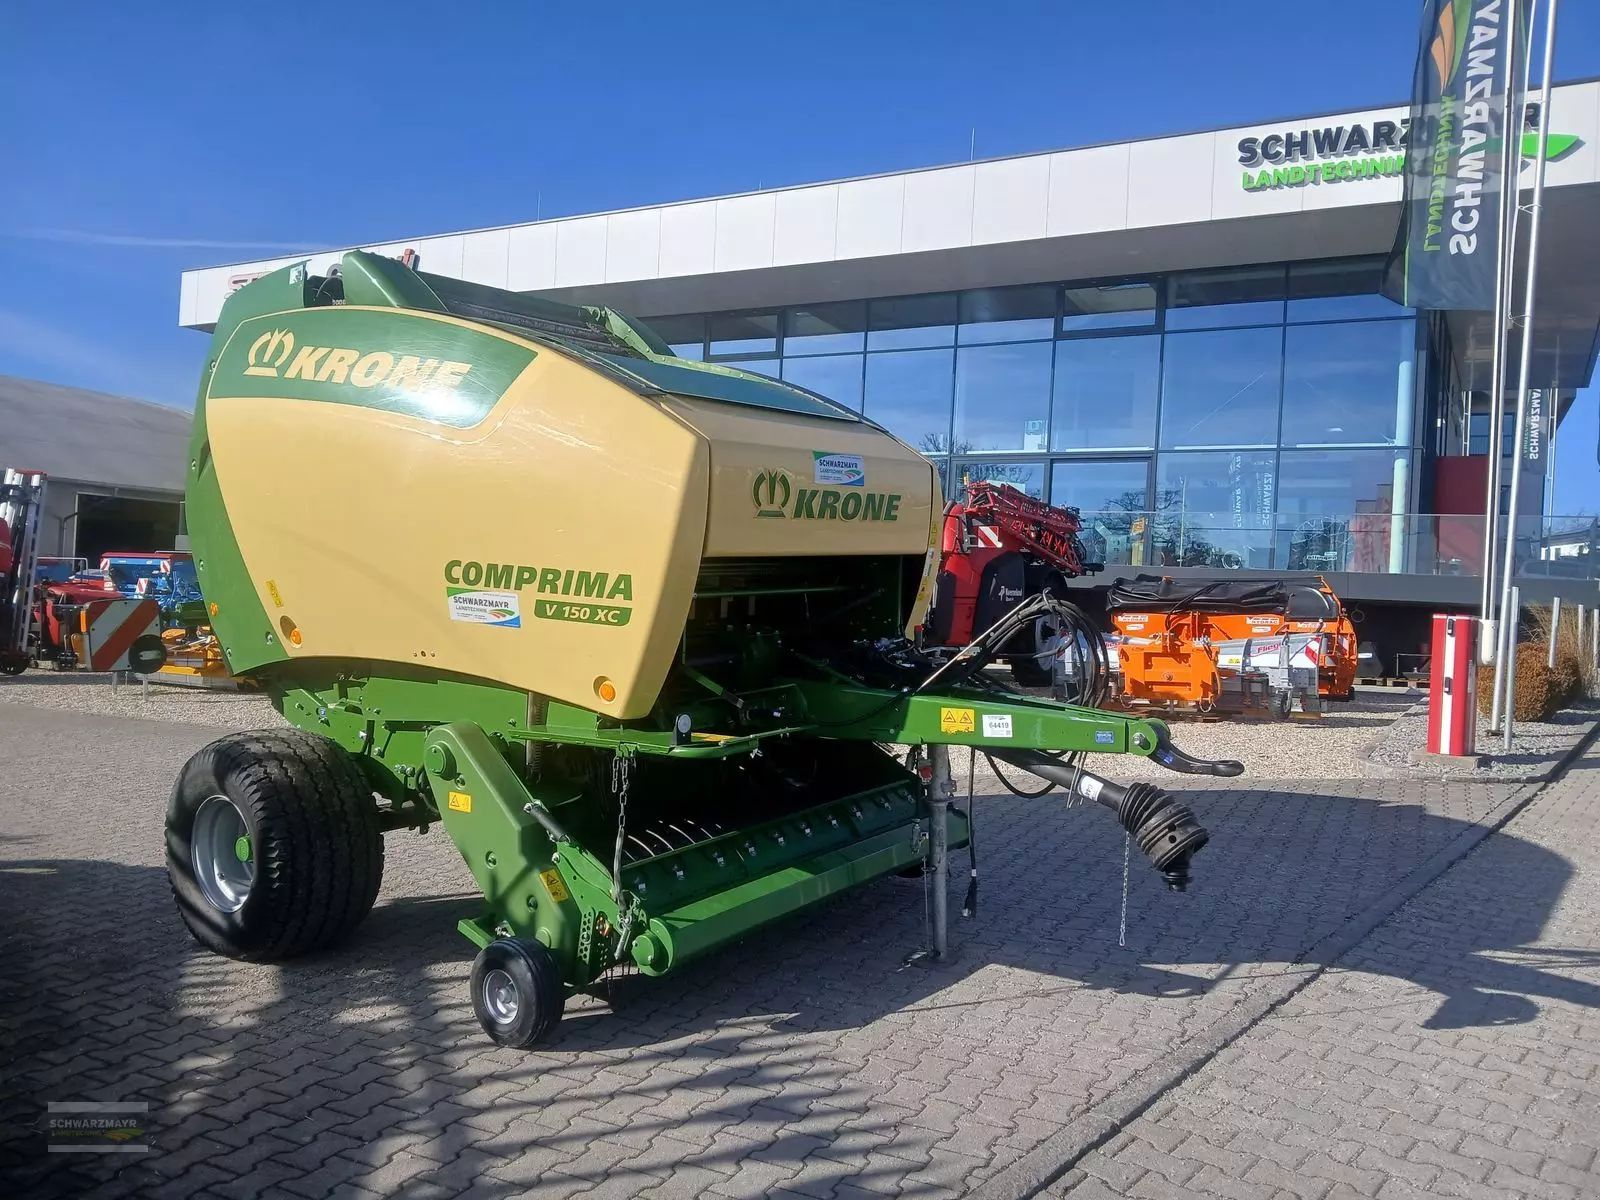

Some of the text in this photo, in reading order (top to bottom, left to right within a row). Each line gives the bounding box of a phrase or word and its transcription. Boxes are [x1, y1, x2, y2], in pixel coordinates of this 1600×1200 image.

[283, 346, 472, 392] KRONE
[819, 459, 858, 469] SCHWARZMAYR
[793, 489, 901, 520] KRONE
[445, 560, 632, 601] COMPRIMA
[453, 596, 509, 609] SCHWARZMAYR
[545, 604, 620, 623] V 150 XC
[1257, 642, 1281, 653] Flieg
